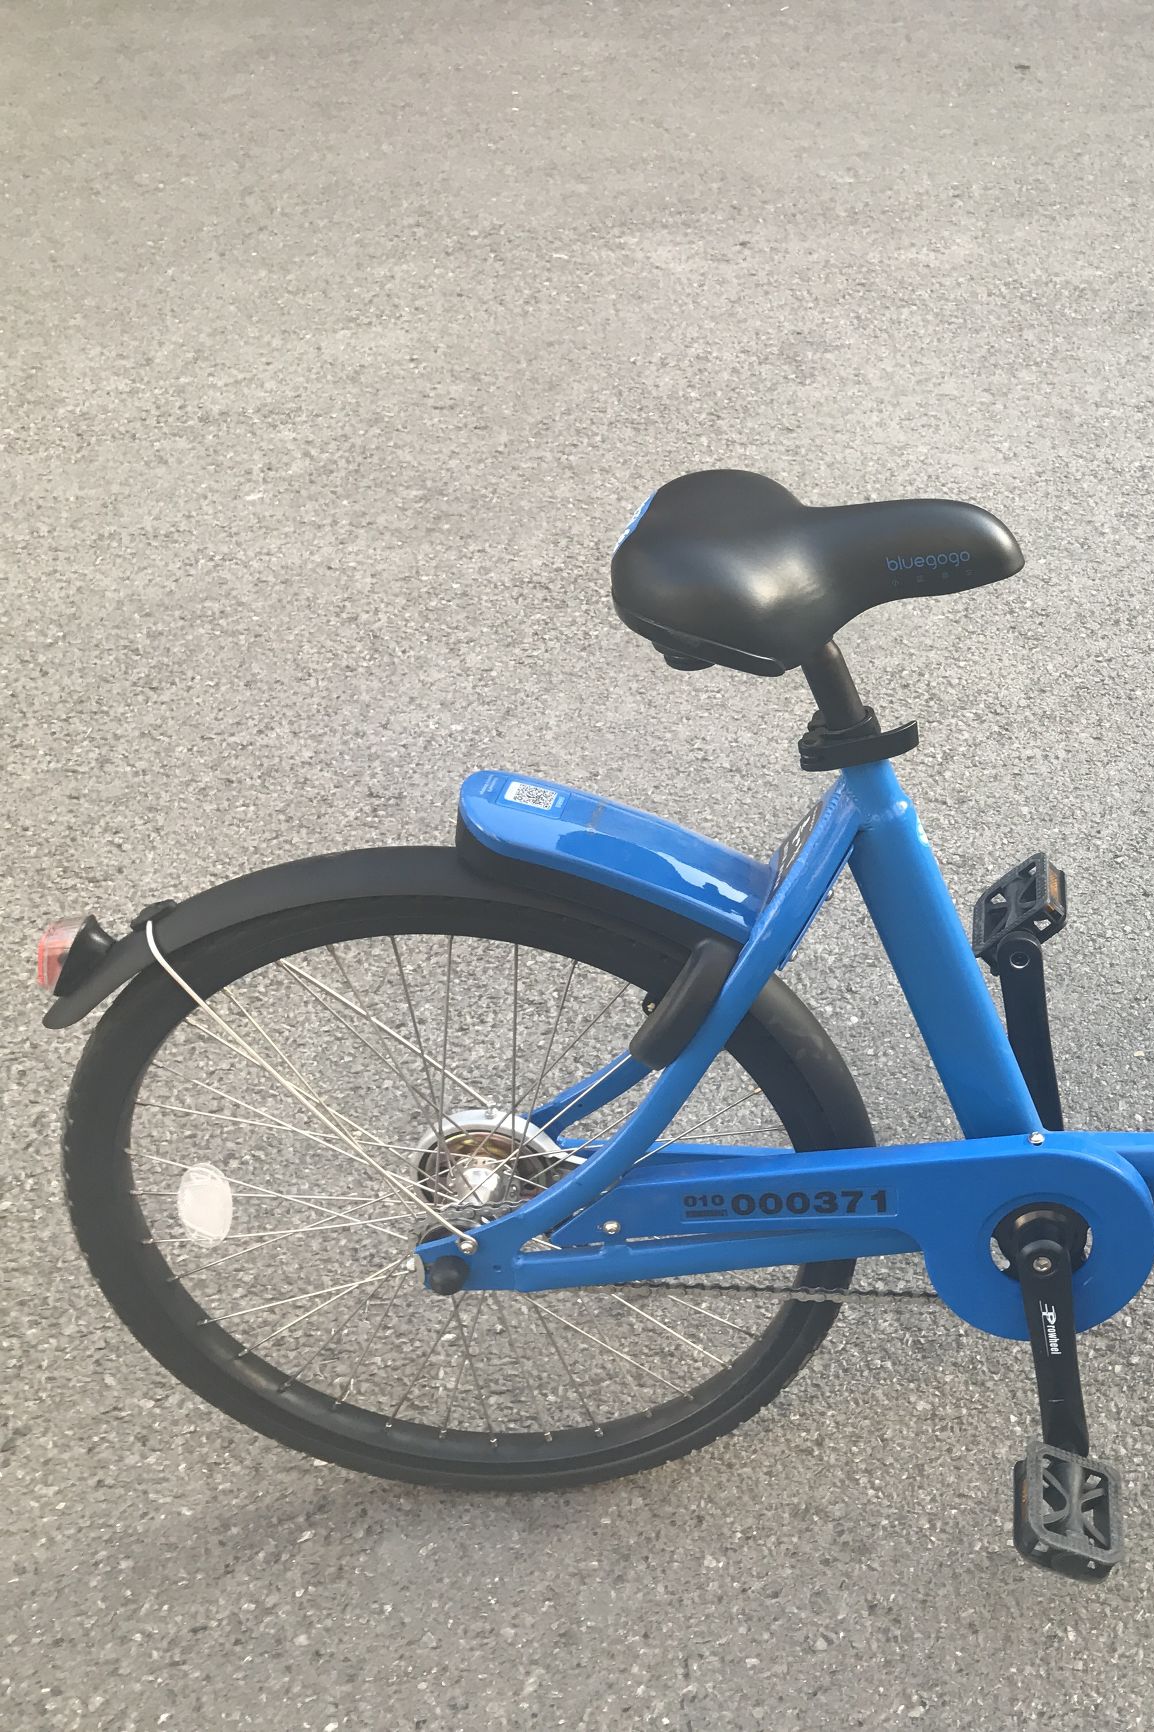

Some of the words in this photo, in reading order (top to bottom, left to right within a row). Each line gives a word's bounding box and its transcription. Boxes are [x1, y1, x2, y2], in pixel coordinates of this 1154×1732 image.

[886, 551, 970, 571] bluegogo
[684, 1195, 725, 1208] 010
[731, 1190, 888, 1216] 000371
